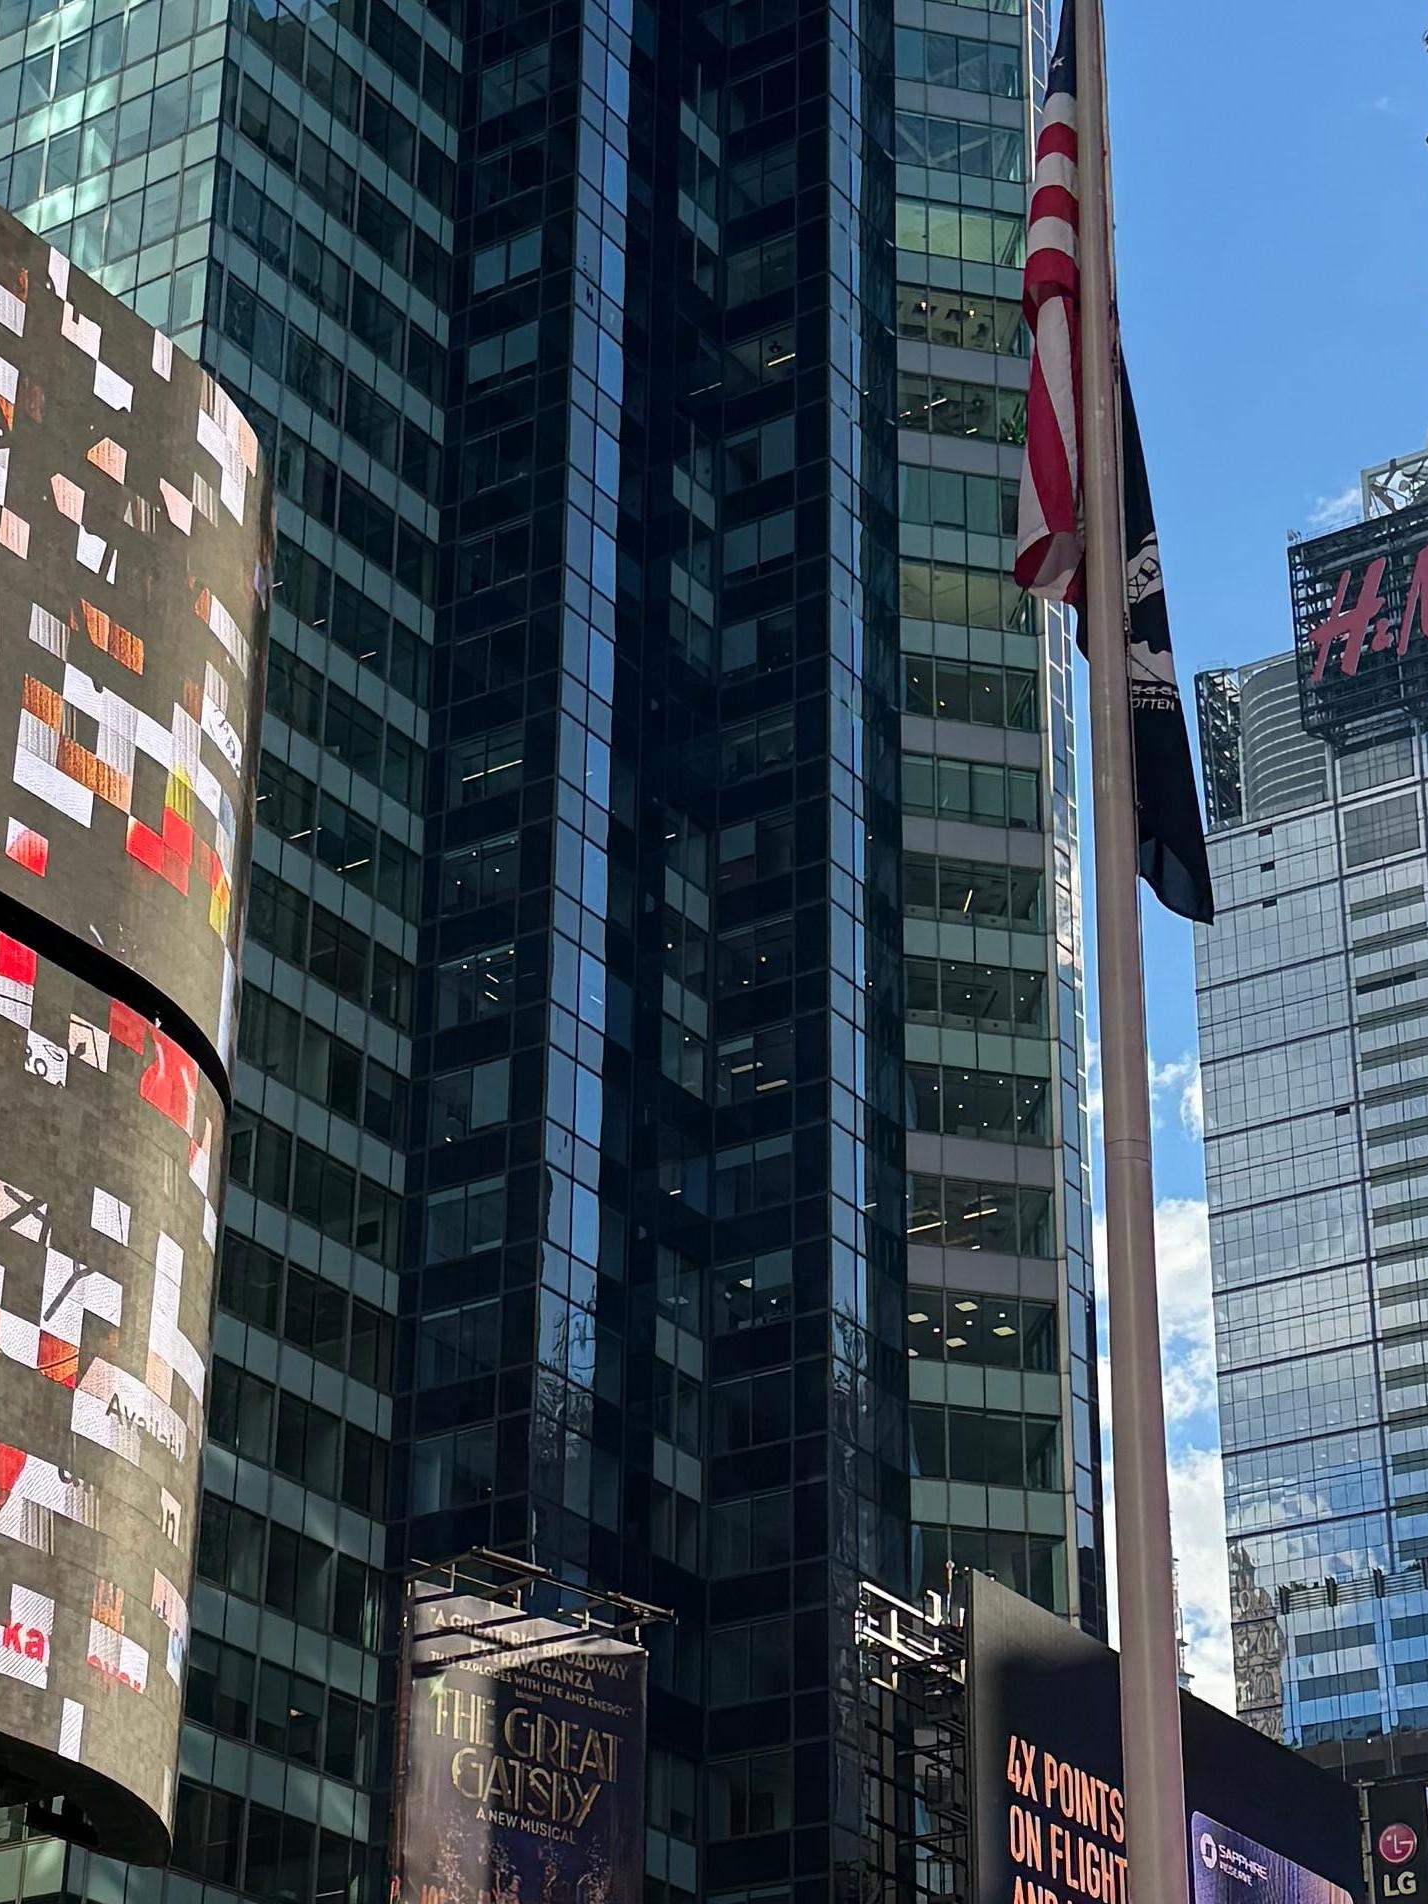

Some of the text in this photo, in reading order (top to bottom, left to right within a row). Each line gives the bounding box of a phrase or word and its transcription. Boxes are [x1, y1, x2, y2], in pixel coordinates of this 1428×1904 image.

[459, 1659, 512, 1684] EXPLODES
[515, 1675, 541, 1692] WITH
[542, 1682, 563, 1699] LIFE
[565, 1690, 586, 1706] AND
[470, 1639, 594, 1693] EXTRAVAGANZA
[542, 1642, 629, 1681] BROADWAY
[431, 1688, 623, 1784] THE GREAT
[451, 1747, 601, 1828] GATSBY
[1007, 1735, 1125, 1844] 4X POINTS
[476, 1806, 576, 1846] A NEW MUSICAL
[1009, 1805, 1042, 1872] ON
[1219, 1844, 1269, 1881] SAPPHIRE
[1383, 1871, 1416, 1896] LG
